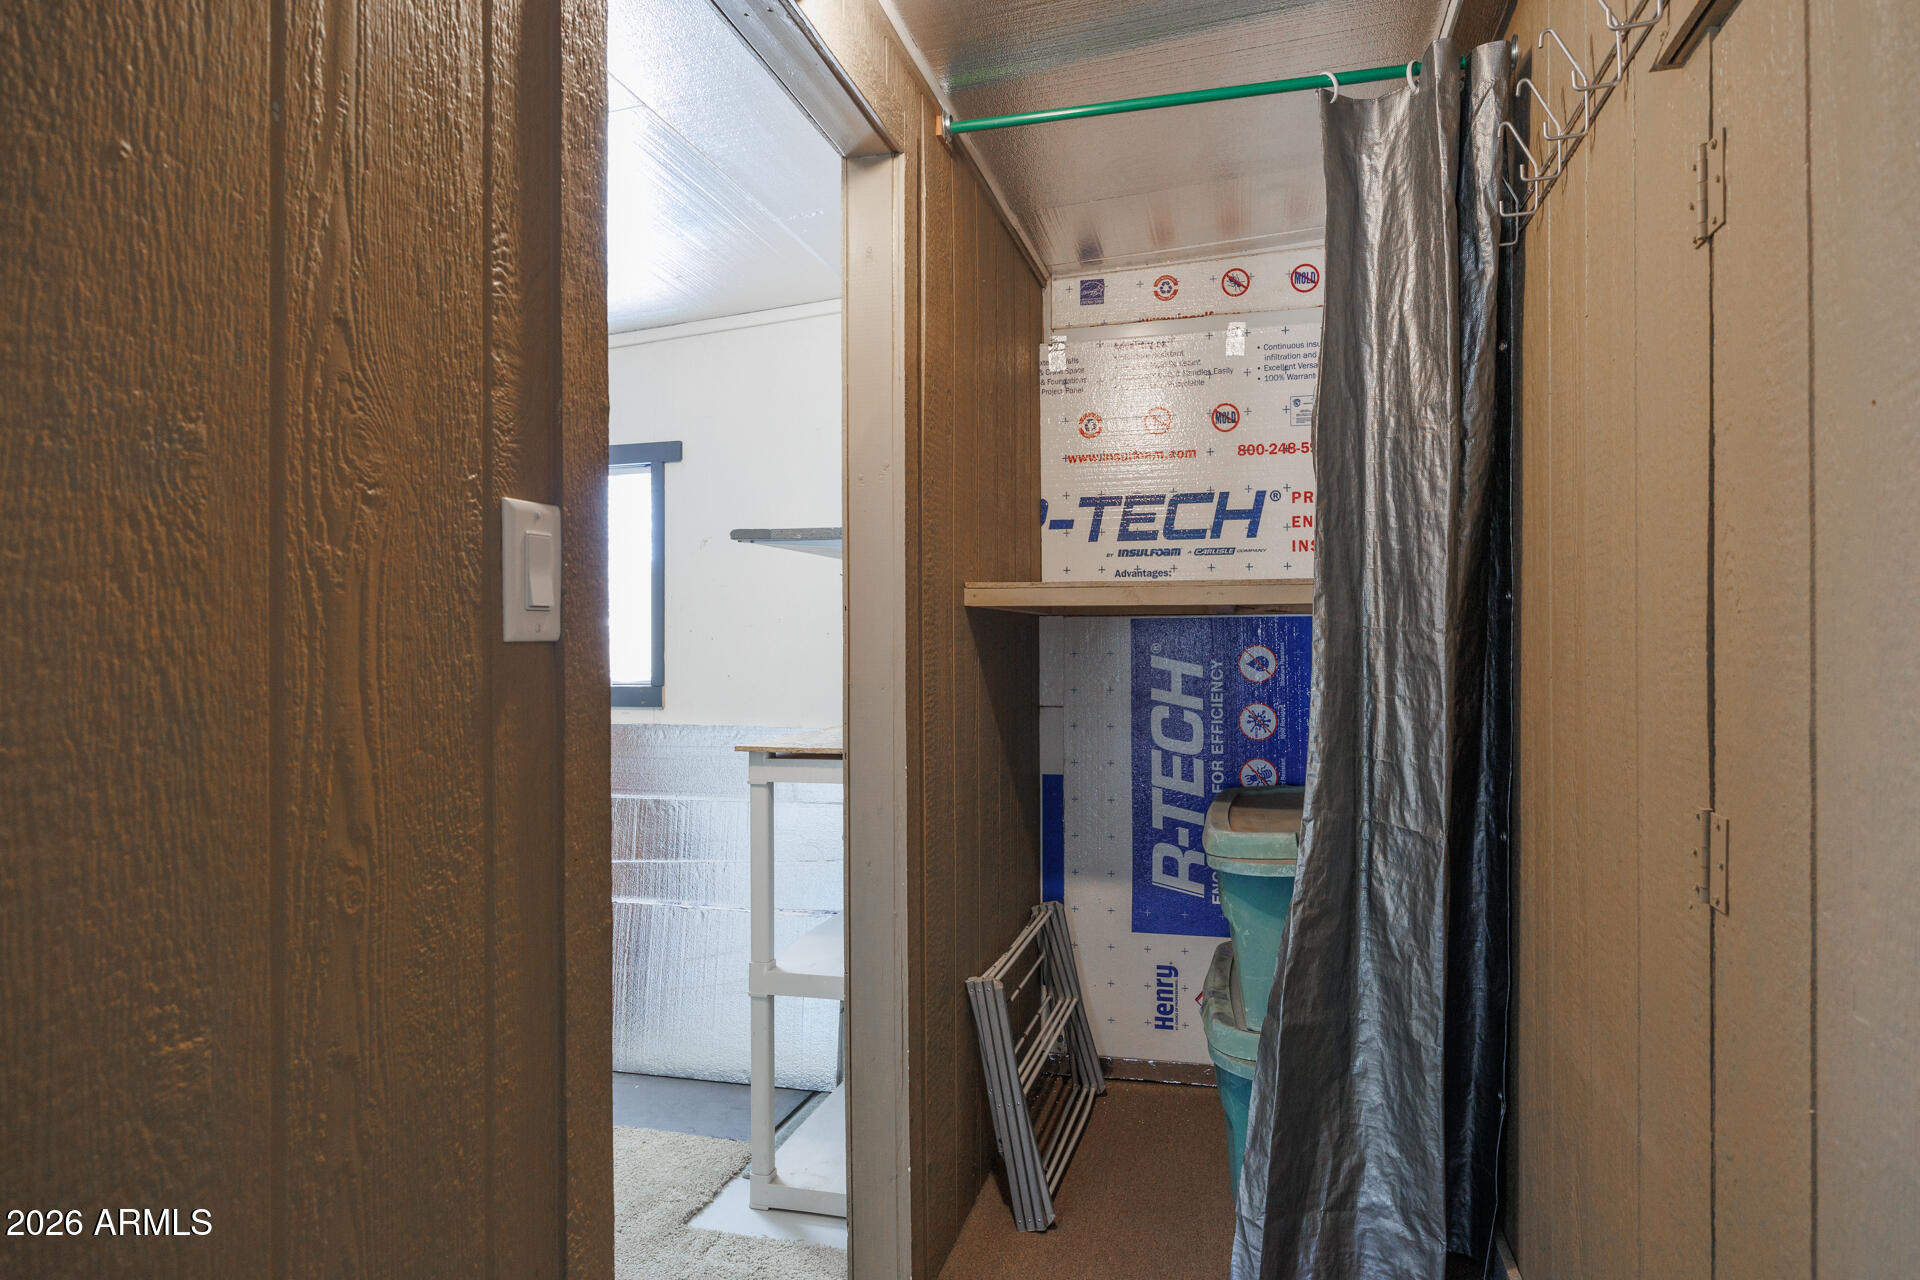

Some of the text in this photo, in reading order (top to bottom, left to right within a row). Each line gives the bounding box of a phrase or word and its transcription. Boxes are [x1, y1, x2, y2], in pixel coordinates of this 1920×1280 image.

[1294, 271, 1316, 285] MOLD
[1263, 342, 1305, 351] Continuous
[1264, 351, 1317, 361] infiltration and
[1213, 366, 1234, 375] Easily
[1263, 363, 1297, 372] Excellent
[1264, 374, 1285, 382] 100%
[1041, 387, 1084, 397] Project Panel
[1215, 411, 1236, 425] MOLD
[1194, 547, 1235, 556] CARLISLE
[1115, 568, 1172, 579] Advantages:
[1210, 659, 1224, 758] EFFICIENCY
[1211, 760, 1224, 793] FOR
[1154, 965, 1179, 1030] Henry
